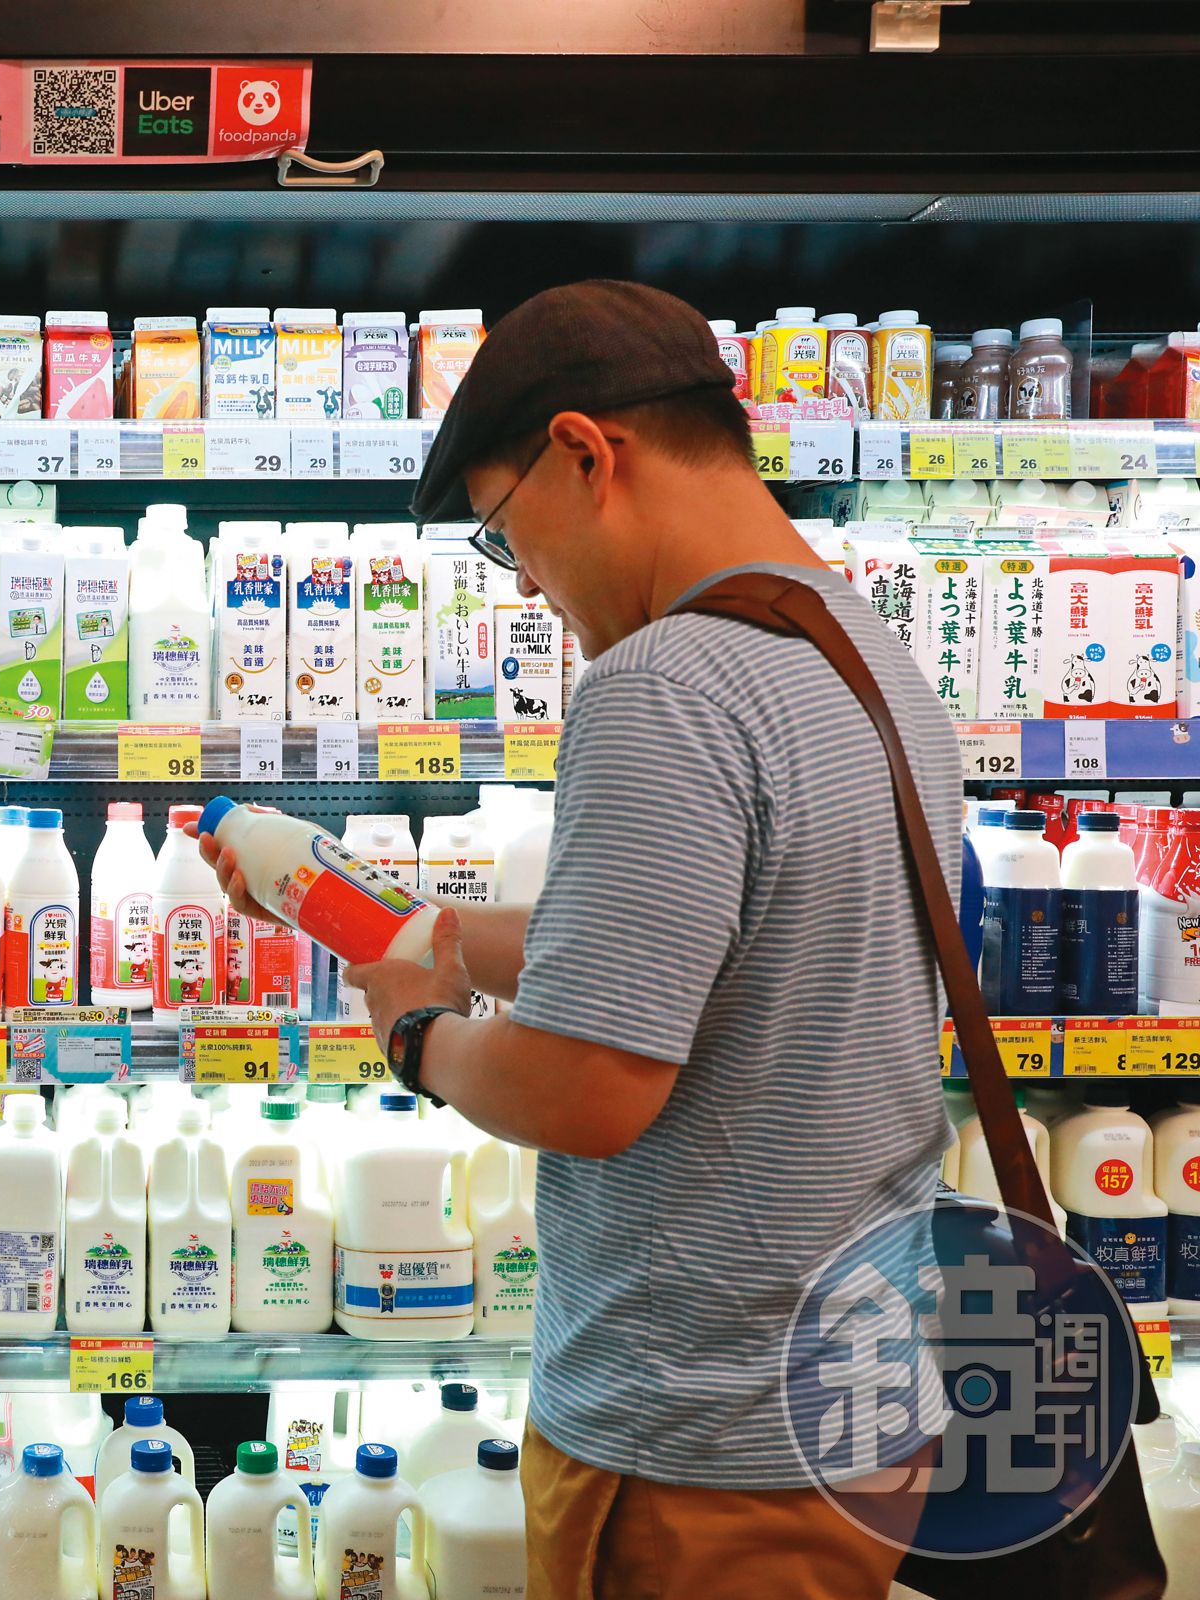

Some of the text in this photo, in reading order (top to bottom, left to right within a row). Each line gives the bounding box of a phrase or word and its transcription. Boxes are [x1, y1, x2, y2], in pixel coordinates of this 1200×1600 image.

[138, 91, 194, 112] Uber
[138, 115, 193, 135] Eats
[219, 128, 297, 145] foodpanda
[214, 339, 271, 355] MILK
[794, 349, 815, 360] 光泉
[52, 354, 101, 363] 西瓜牛乳
[214, 374, 260, 385] 高鈣牛乳
[38, 457, 64, 472] 37
[96, 458, 113, 468] 29
[255, 456, 281, 472] 29
[389, 457, 416, 474] 30
[817, 458, 844, 475] 26
[928, 454, 946, 465] 26
[1120, 455, 1148, 471] 24
[940, 561, 962, 572] 特選
[475, 560, 488, 594] 北海道
[233, 581, 274, 597] 乳香世家
[965, 577, 977, 638] 北海道十勝
[1070, 583, 1088, 630] 高大鮮乳
[453, 560, 471, 690] 別海のおいしい牛乳
[510, 622, 535, 633] HIGH
[510, 633, 552, 645] QUALITY
[937, 577, 961, 699] よつ葉牛乳
[528, 643, 552, 655] MILK
[168, 759, 195, 777] 98
[258, 761, 276, 771] 91
[414, 758, 455, 775] 185
[975, 756, 1015, 773] 192
[1073, 758, 1099, 769] 108
[449, 870, 476, 880] 林鳳營
[437, 883, 467, 894] HIGH
[44, 919, 67, 928] 光泉
[44, 931, 67, 941] 鮮乳
[1017, 1054, 1043, 1070] 79
[1161, 1053, 1200, 1070] 129
[358, 1062, 386, 1078] 99
[1102, 1175, 1129, 1188] 157
[1095, 1246, 1160, 1262] 牧真鮮乳
[397, 1262, 439, 1276] 超優質
[107, 1373, 147, 1389] 166
